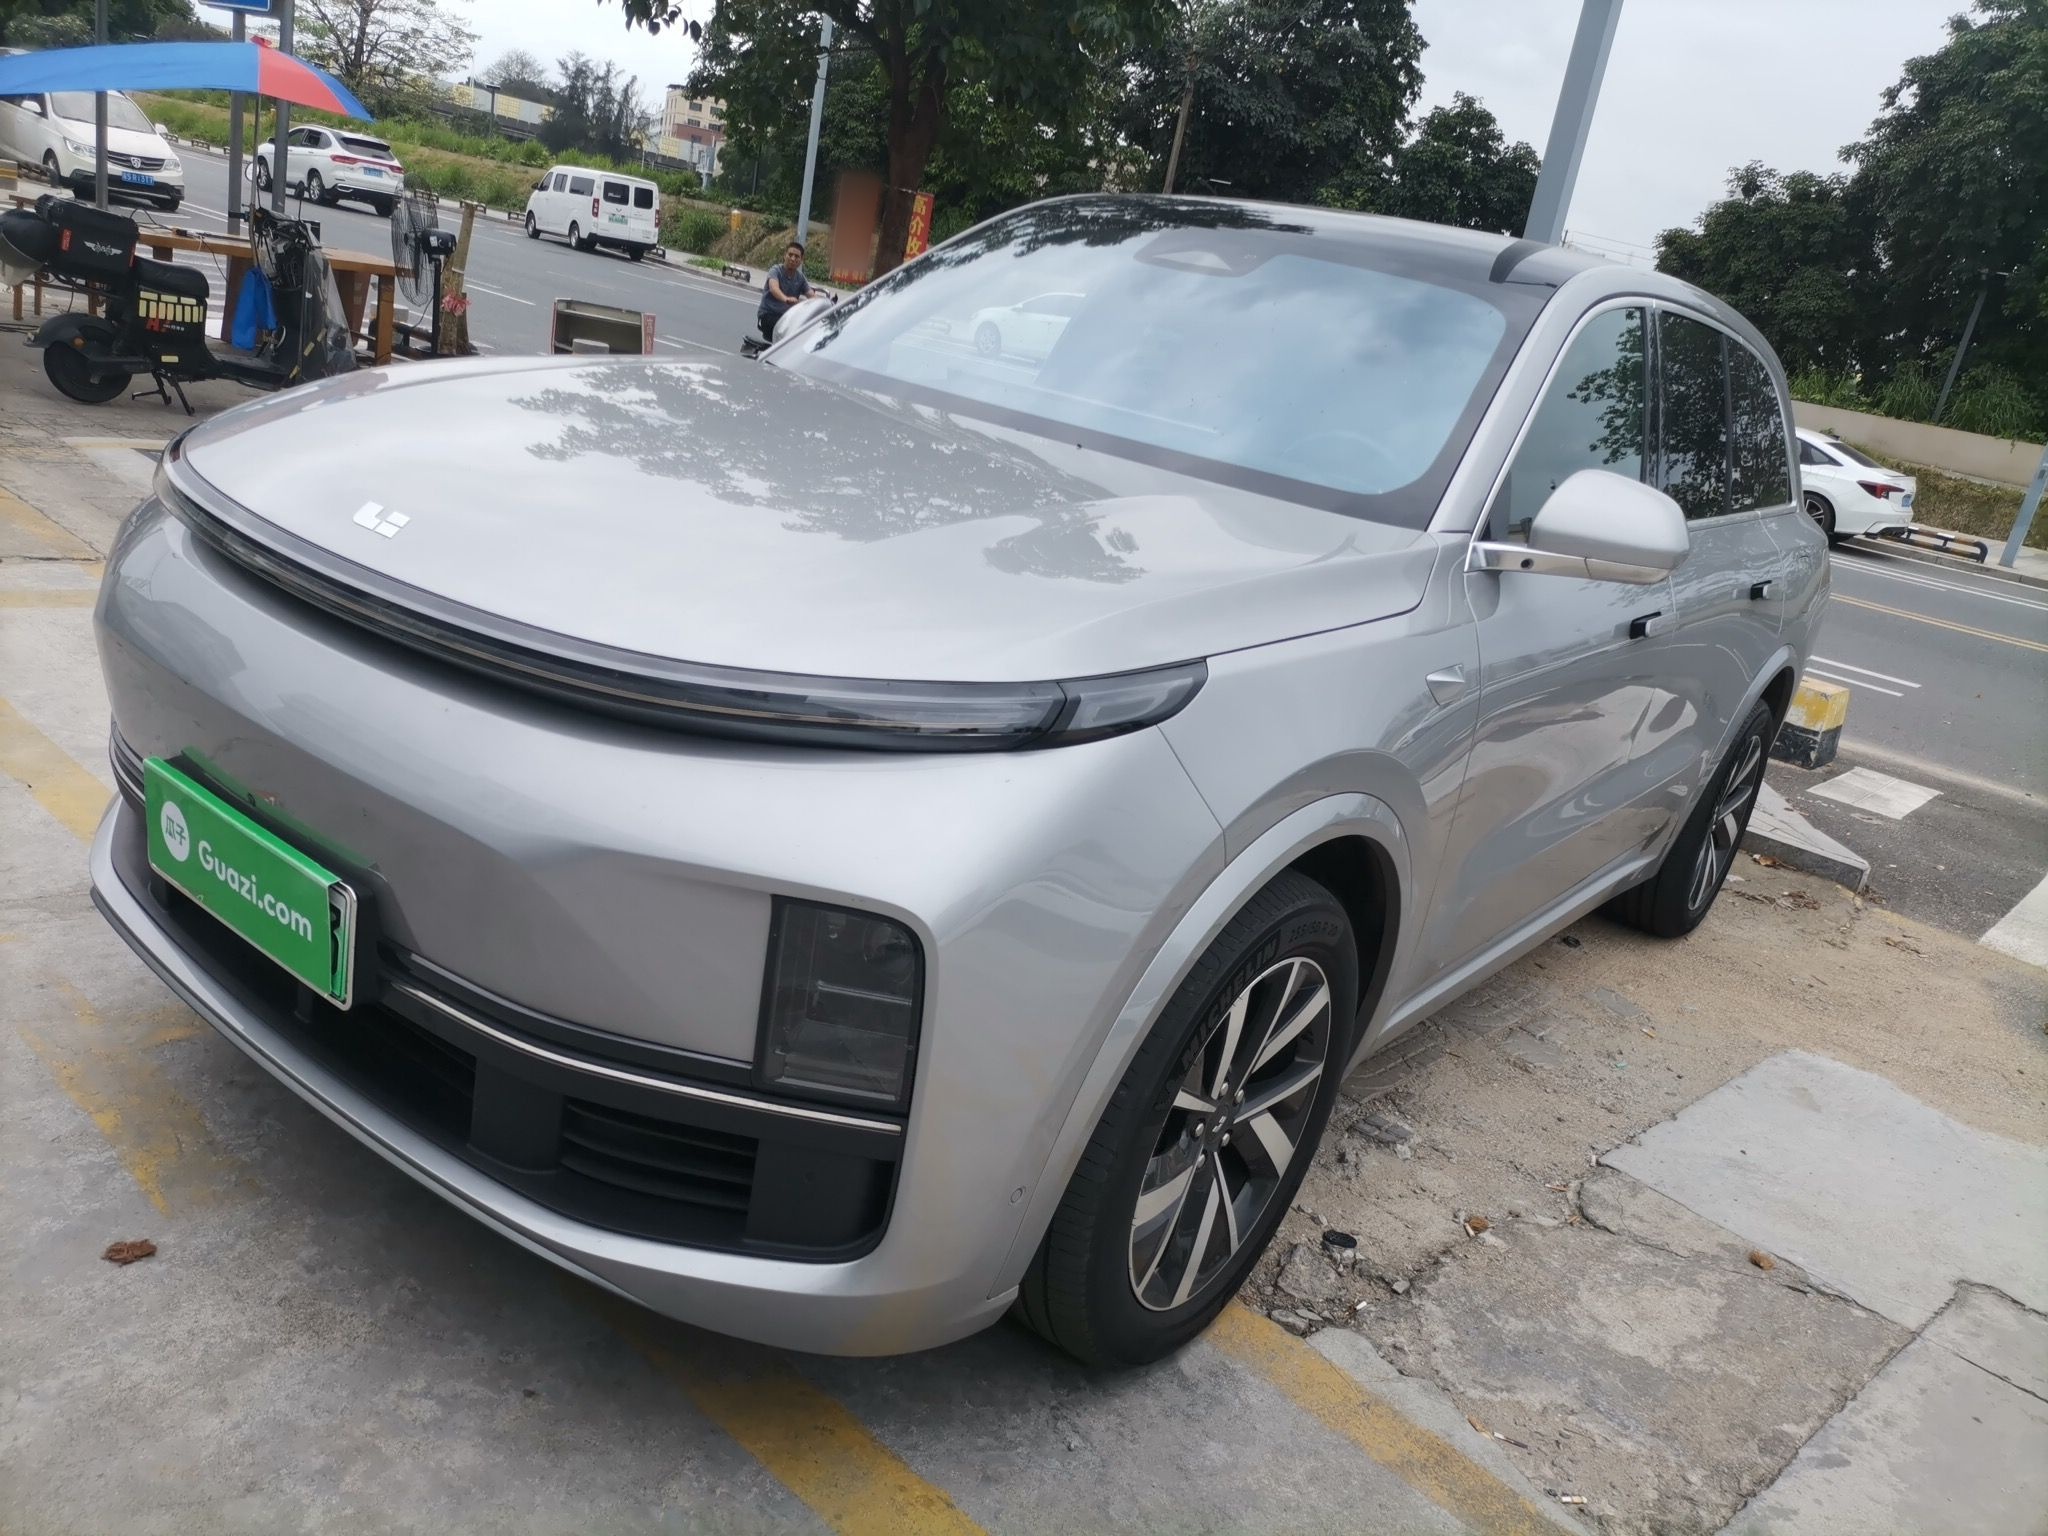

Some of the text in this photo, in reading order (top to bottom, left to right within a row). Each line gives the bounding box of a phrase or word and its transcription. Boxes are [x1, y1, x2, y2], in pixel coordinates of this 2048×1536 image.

[904, 195, 928, 263] 高价收
[165, 815, 187, 847] 瓜子
[198, 840, 312, 943] Guazi.com
[1180, 936, 1279, 1071] MICHELIN
